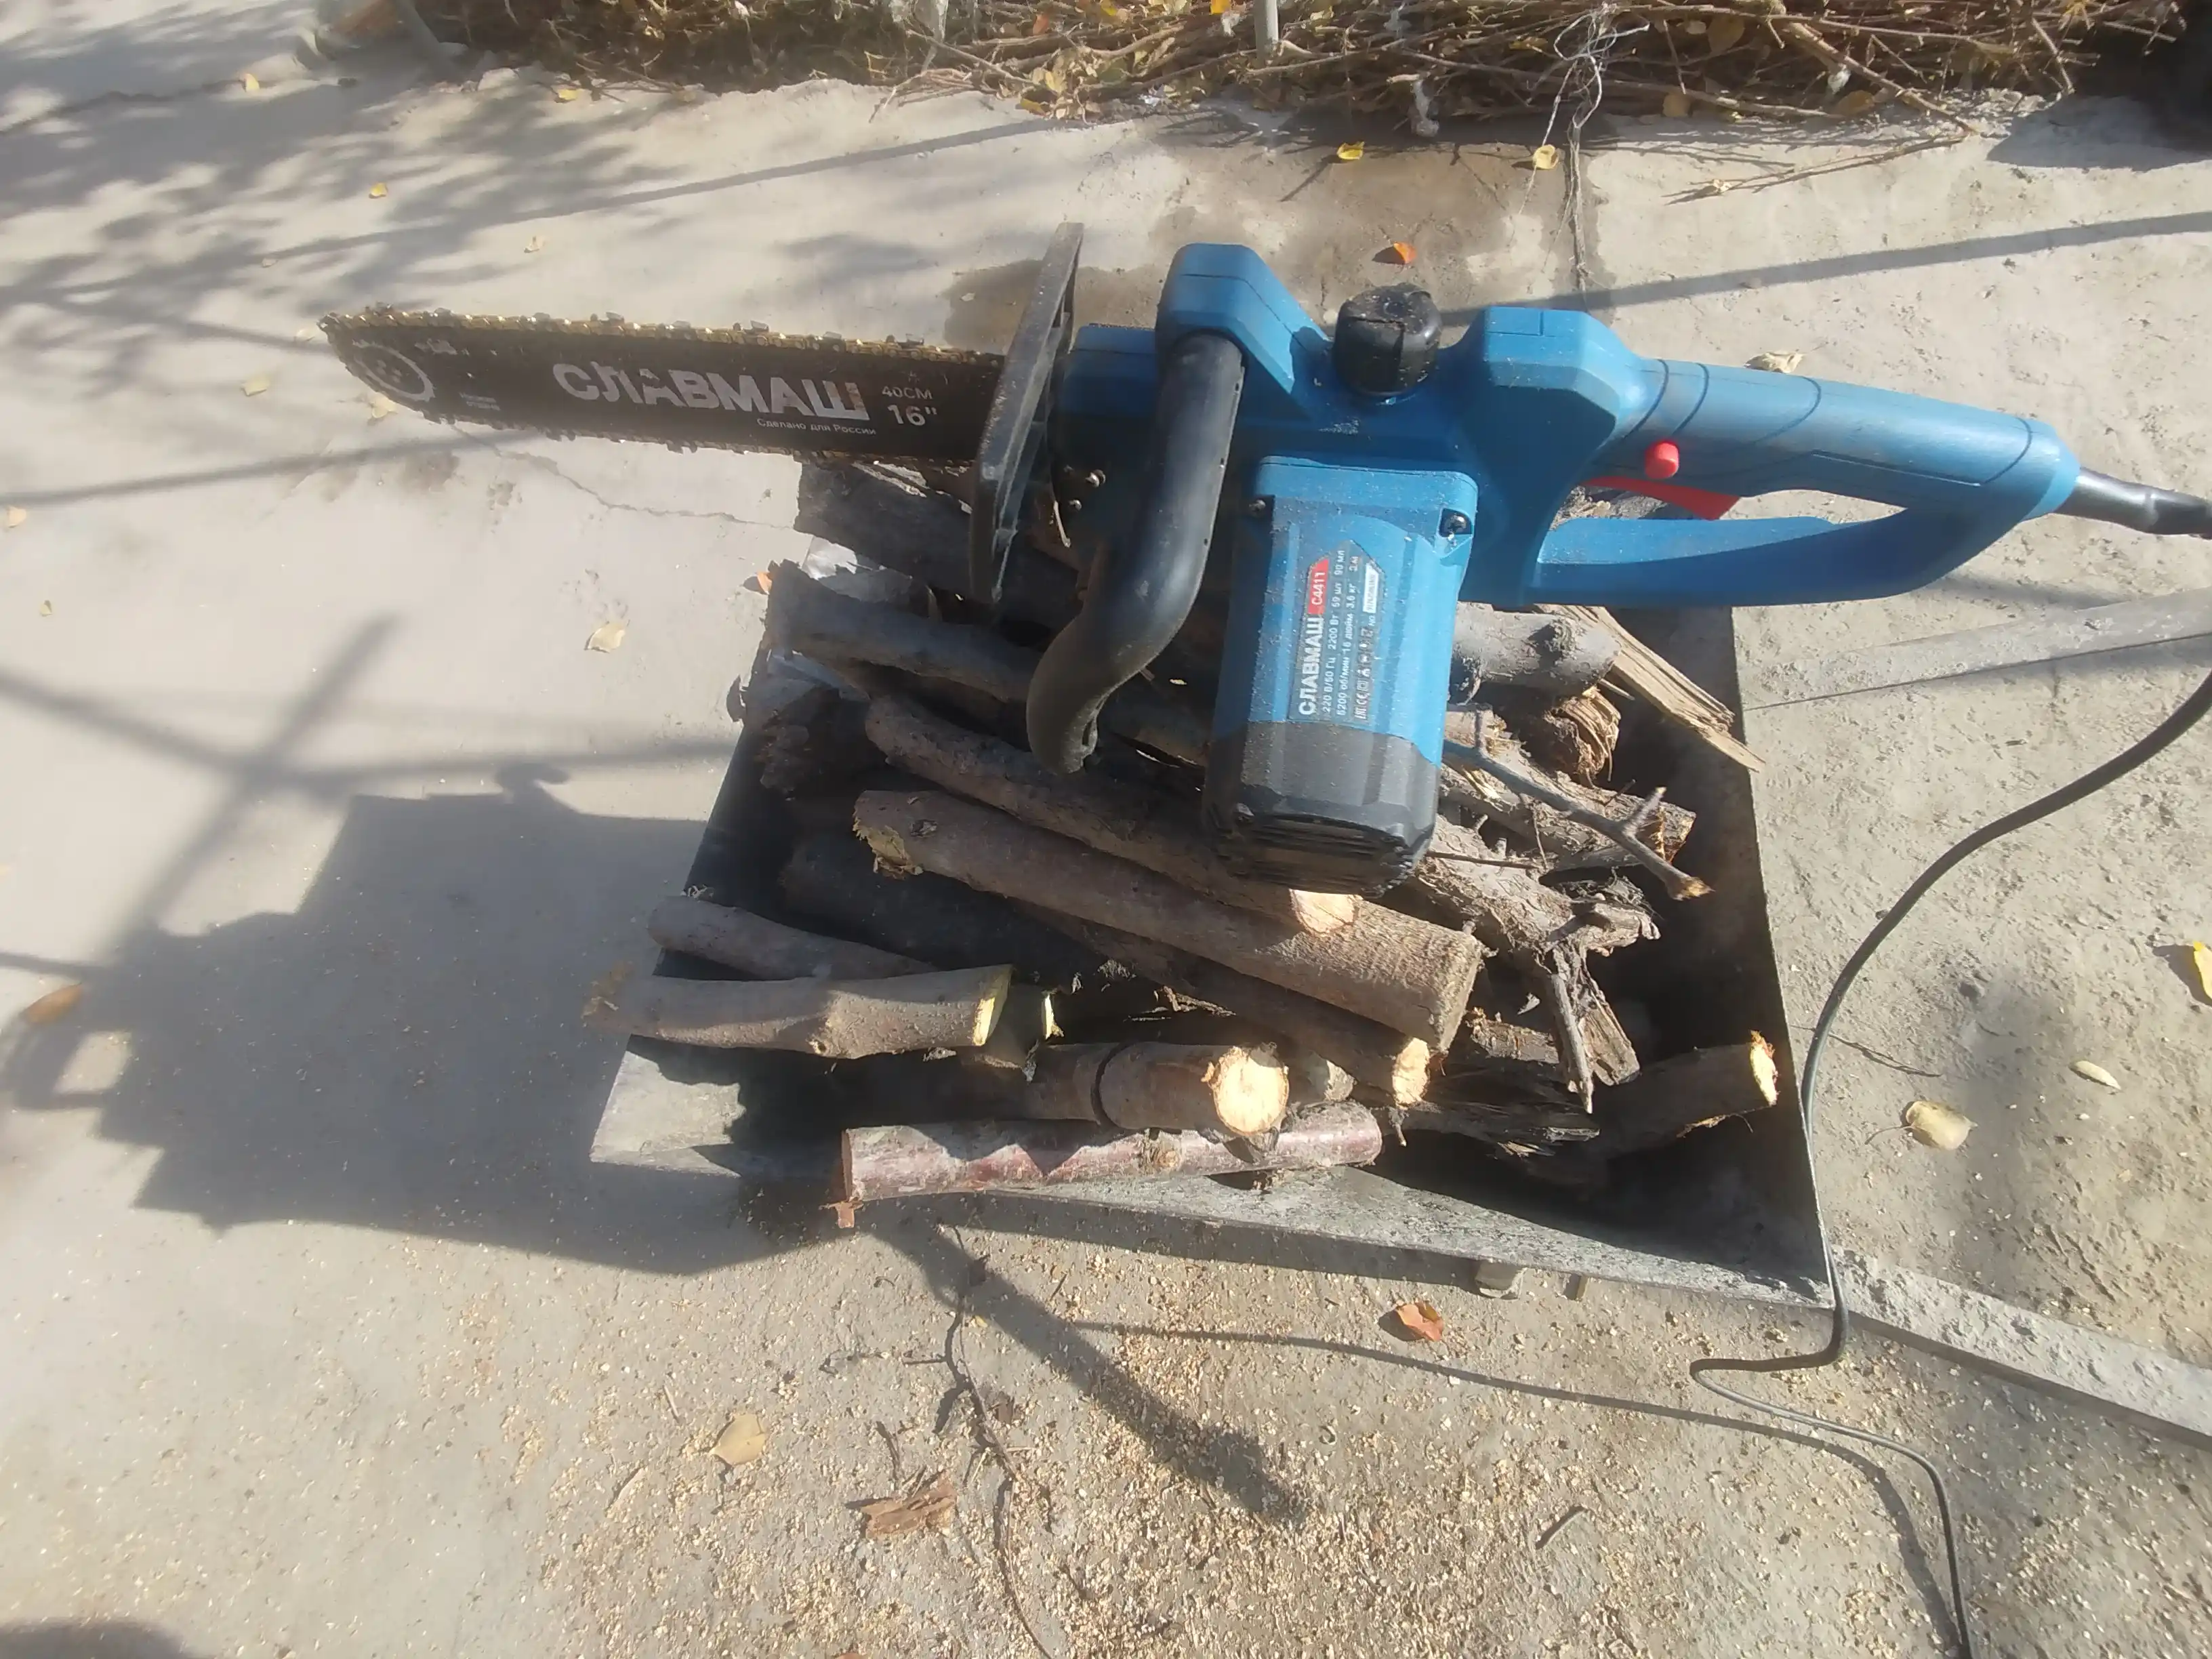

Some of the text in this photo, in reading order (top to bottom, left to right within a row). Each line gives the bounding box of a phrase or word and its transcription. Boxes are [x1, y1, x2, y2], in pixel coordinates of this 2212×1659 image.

[553, 361, 870, 421] СЛАВМАШ
[887, 405, 937, 426] 16"
[756, 418, 877, 435] Сделано для России
[1336, 550, 1346, 563] мл
[1328, 614, 1340, 651] 2200 Вт
[1298, 617, 1324, 716] СЛАВМАШ
[1326, 657, 1337, 669] Гц
[1338, 657, 1351, 691] об/мин
[1322, 695, 1332, 714] 220
